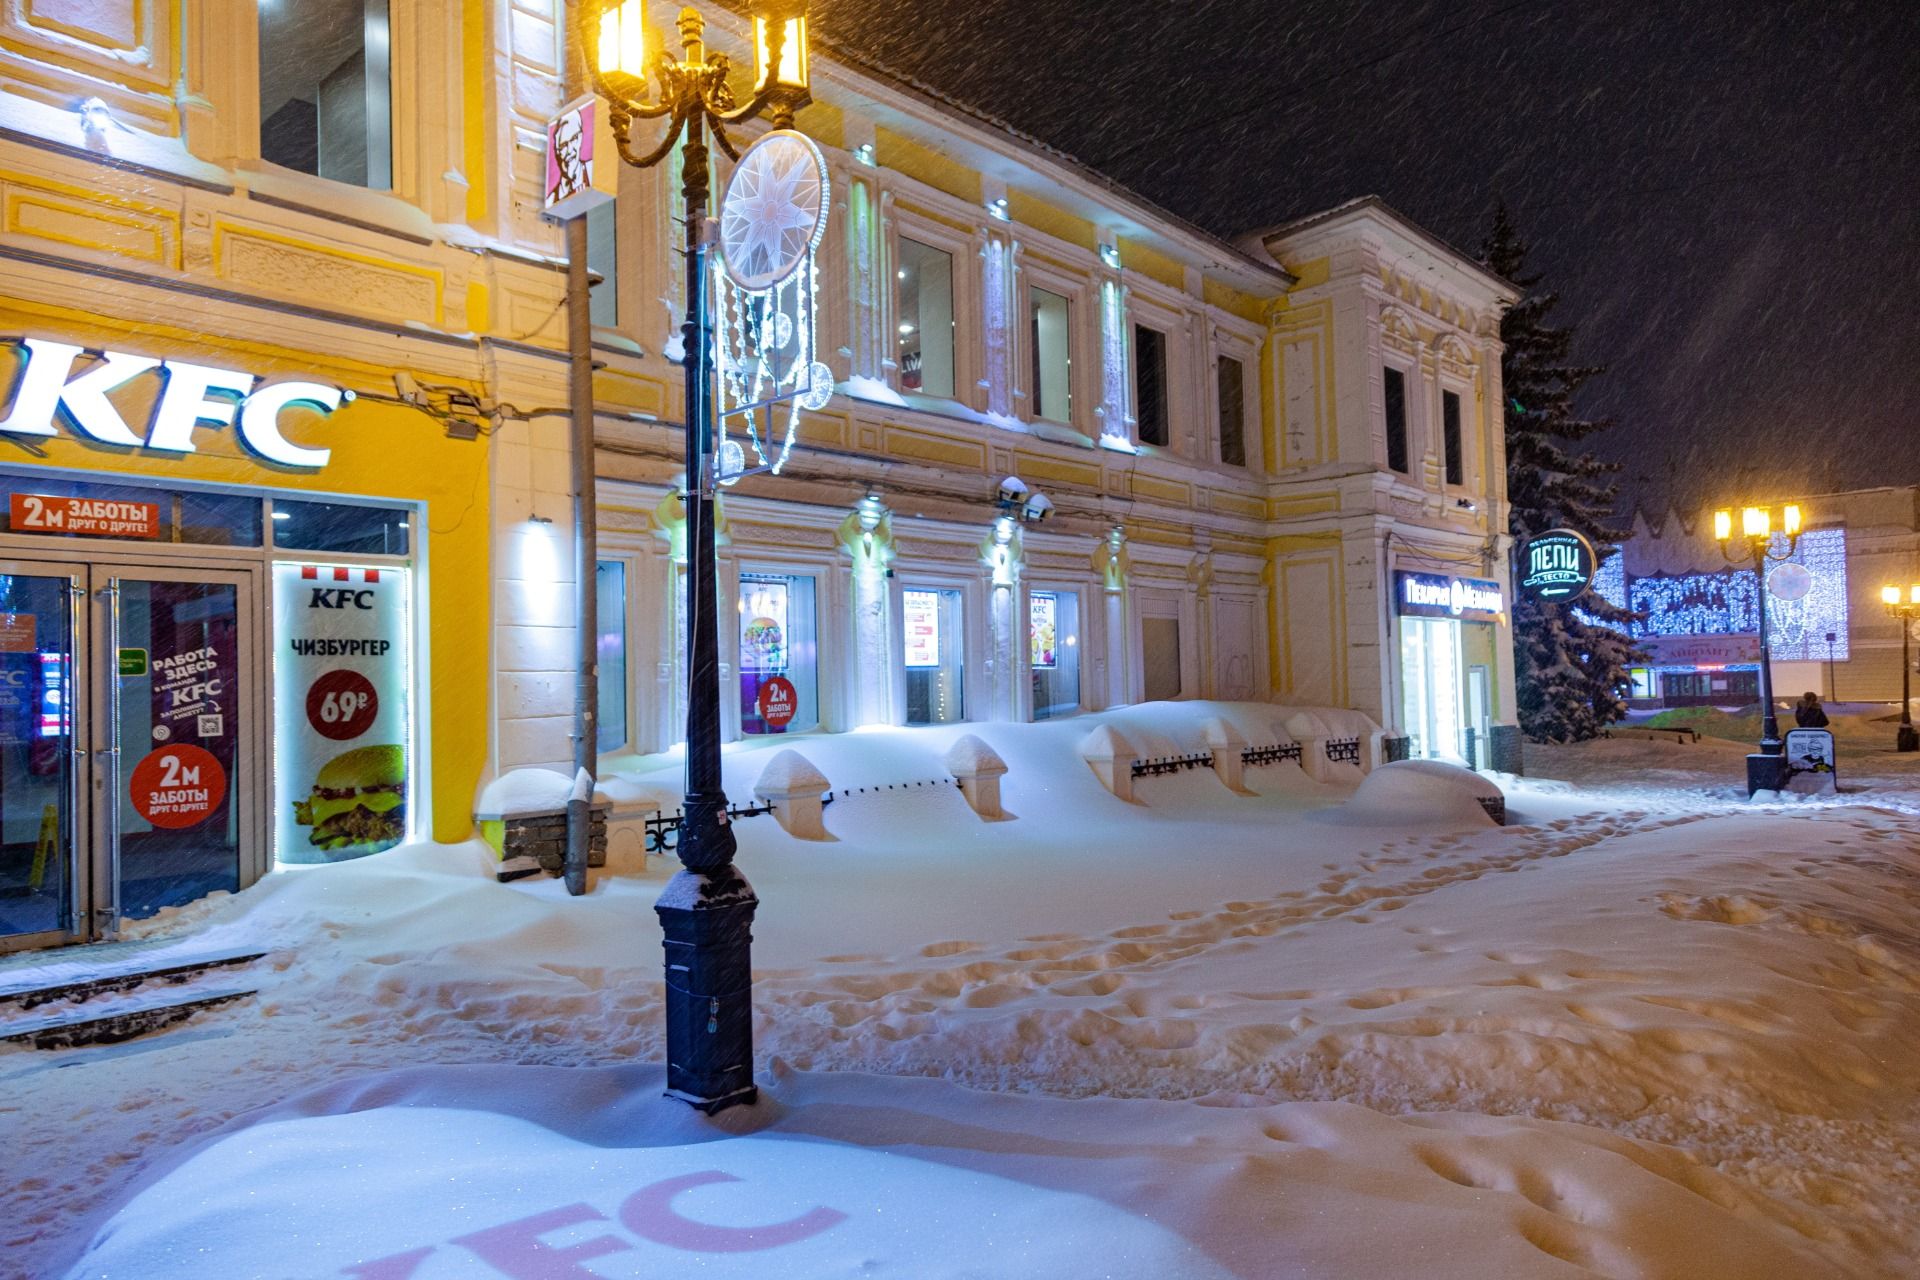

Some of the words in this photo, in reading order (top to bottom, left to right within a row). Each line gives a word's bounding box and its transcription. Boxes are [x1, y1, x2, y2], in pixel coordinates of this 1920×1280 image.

[68, 500, 148, 521] ЗАБОТЫ
[68, 517, 97, 530] ДРУГ
[99, 520, 108, 530] О
[110, 521, 148, 533] ДРУГЕ!
[1529, 544, 1580, 575] ЛЕПИ
[308, 587, 375, 610] KFC
[290, 638, 391, 656] ЧИЗБУРГЕР
[152, 646, 218, 671] РАБОТА
[164, 659, 217, 681] ЗДЕСЬ
[171, 678, 222, 707] KFC
[766, 703, 791, 713] ЗАБОТЫ
[149, 788, 209, 805] ЗАБОТЫ
[149, 804, 170, 816] ДРУГ
